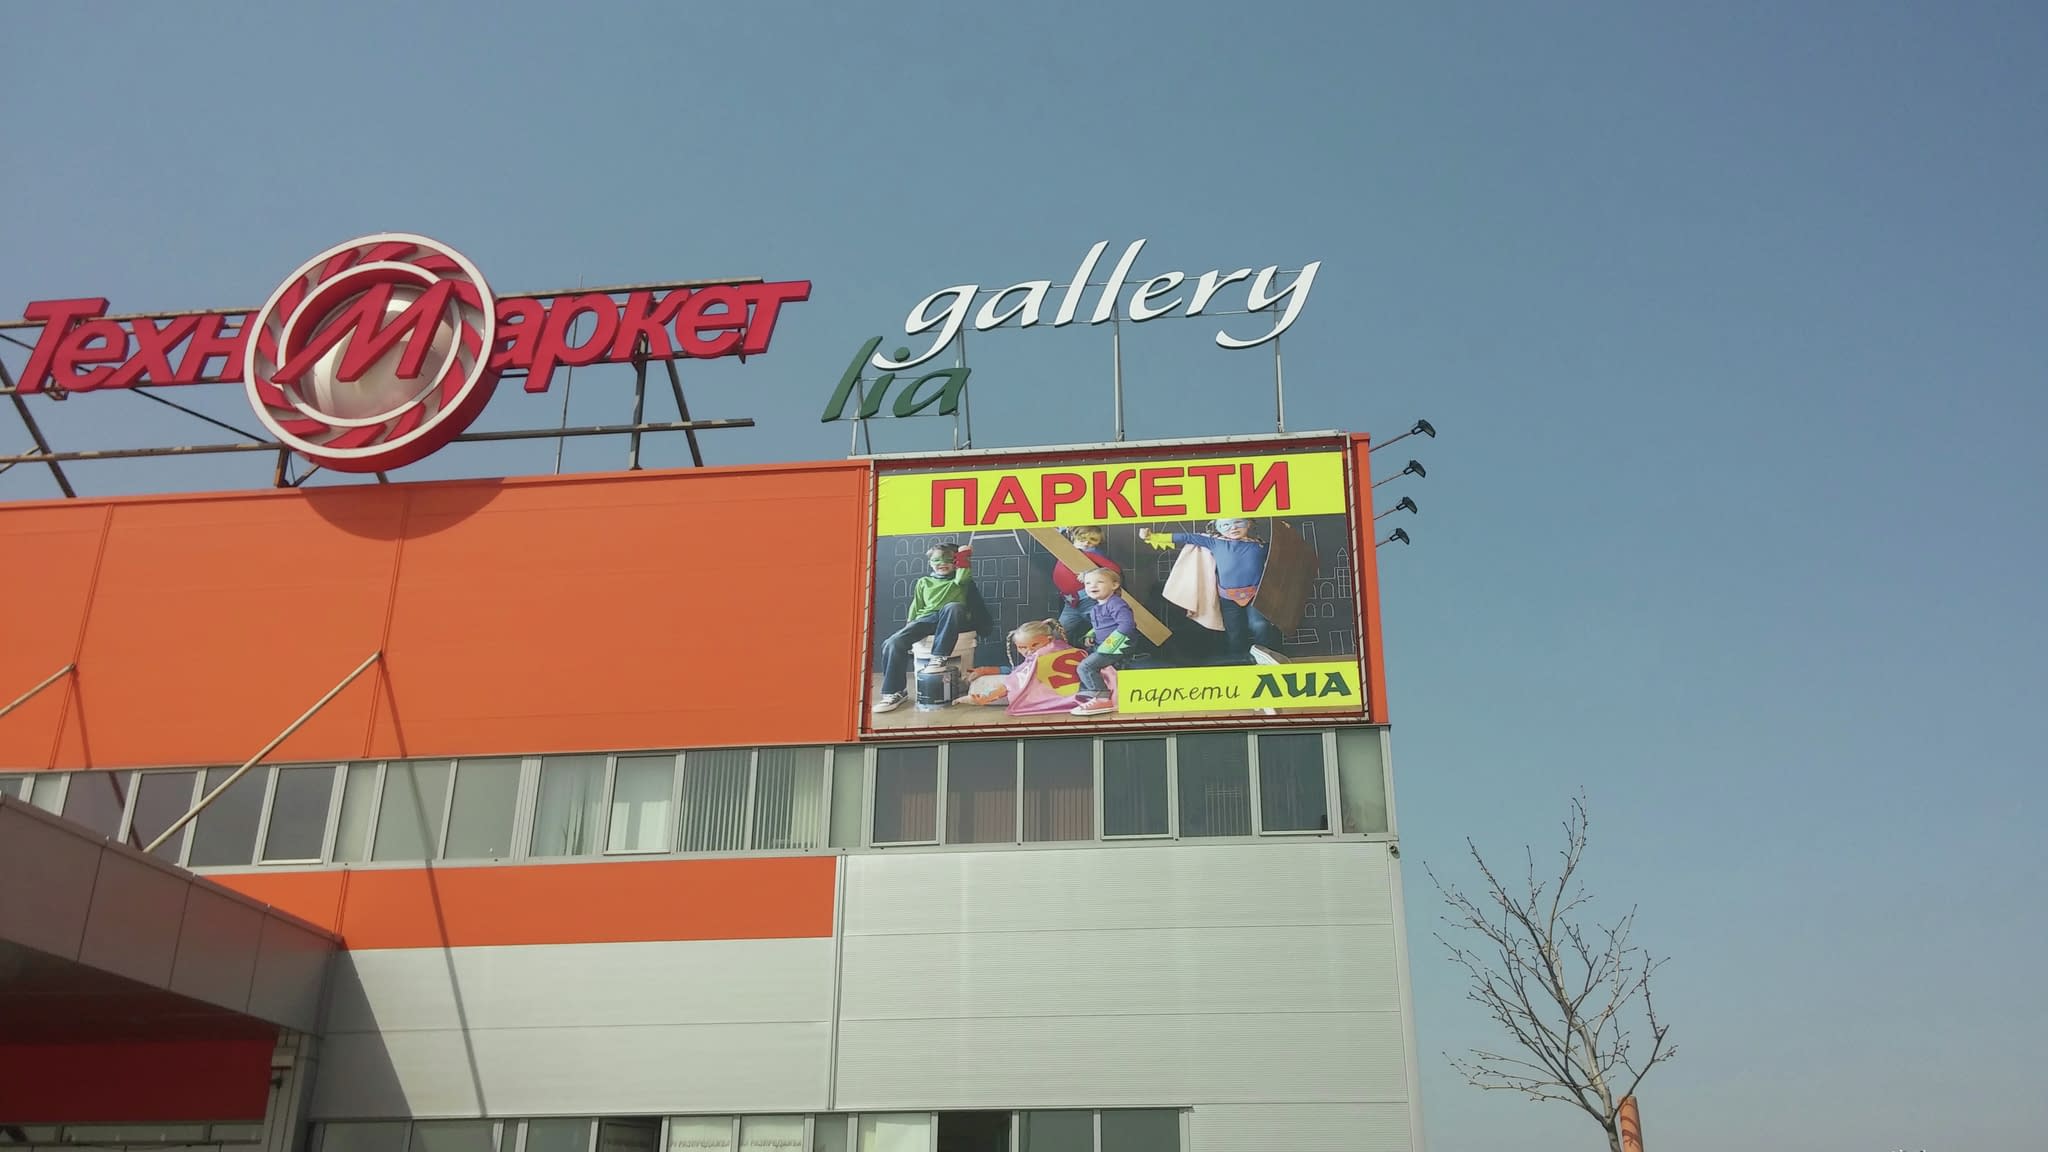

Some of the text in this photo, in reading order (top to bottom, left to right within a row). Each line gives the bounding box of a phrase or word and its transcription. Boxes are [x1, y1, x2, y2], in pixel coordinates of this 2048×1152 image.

[871, 238, 1321, 371] gallery
[821, 335, 972, 423] lia
[930, 460, 1291, 528] ПАРКЕТИ
[1130, 671, 1352, 707] паркети ЛИА
